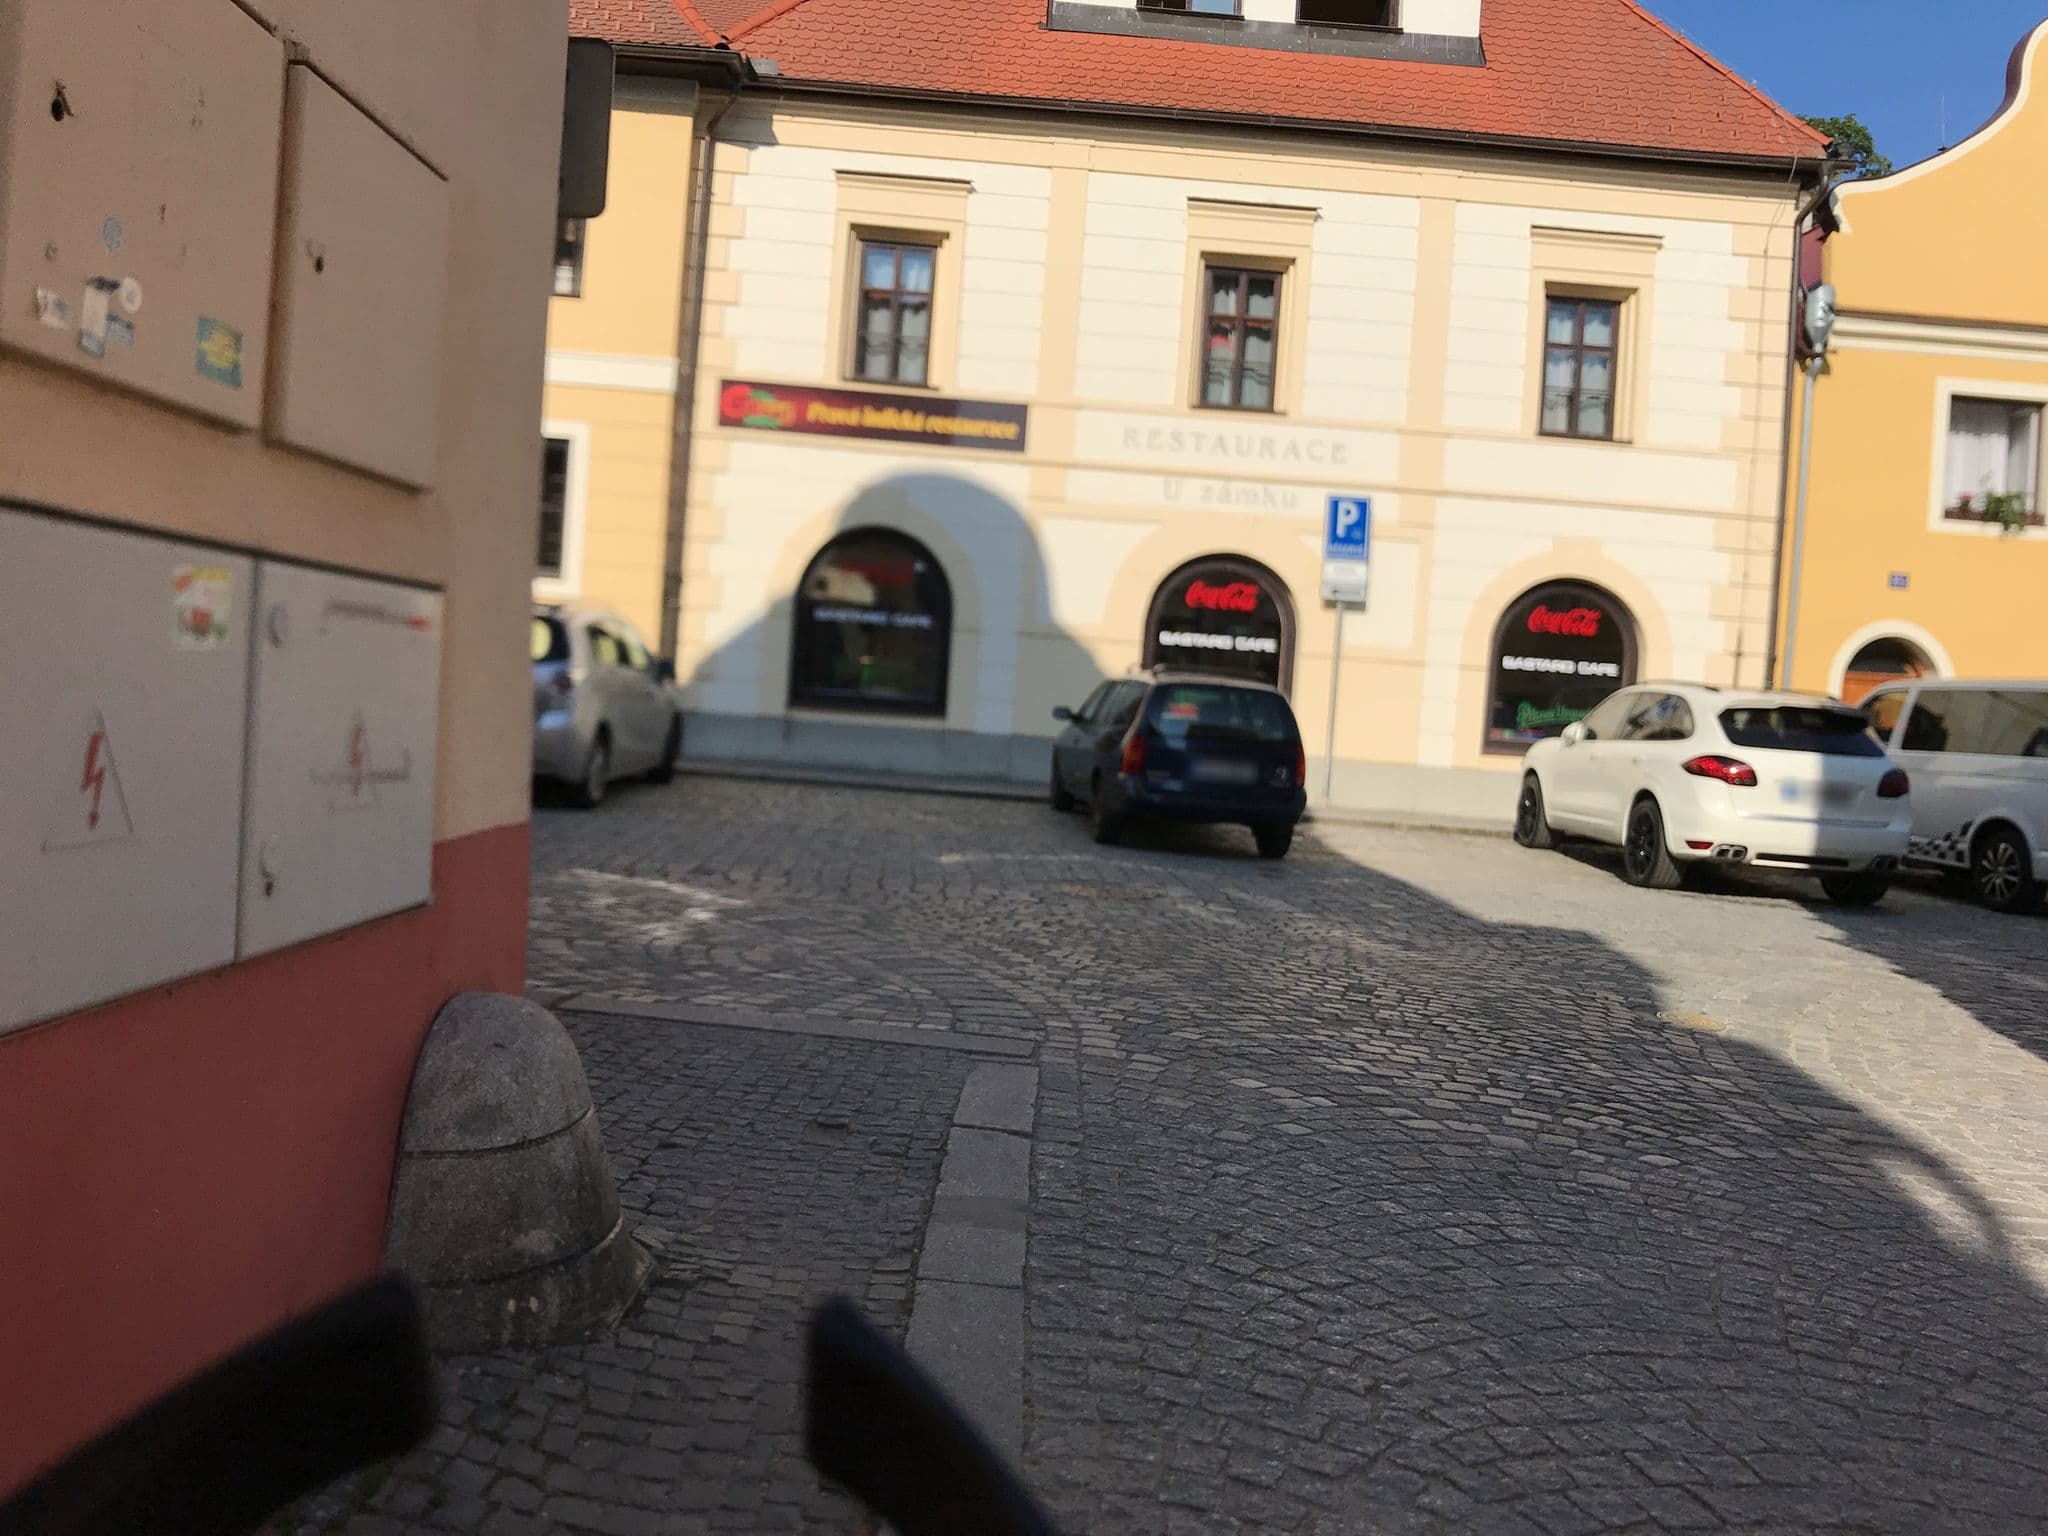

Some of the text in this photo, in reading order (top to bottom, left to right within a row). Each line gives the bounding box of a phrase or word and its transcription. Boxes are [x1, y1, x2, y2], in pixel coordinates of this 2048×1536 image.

[1123, 427, 1348, 464] RESTAURACE
[1163, 478, 1183, 501] U
[1336, 500, 1360, 538] P
